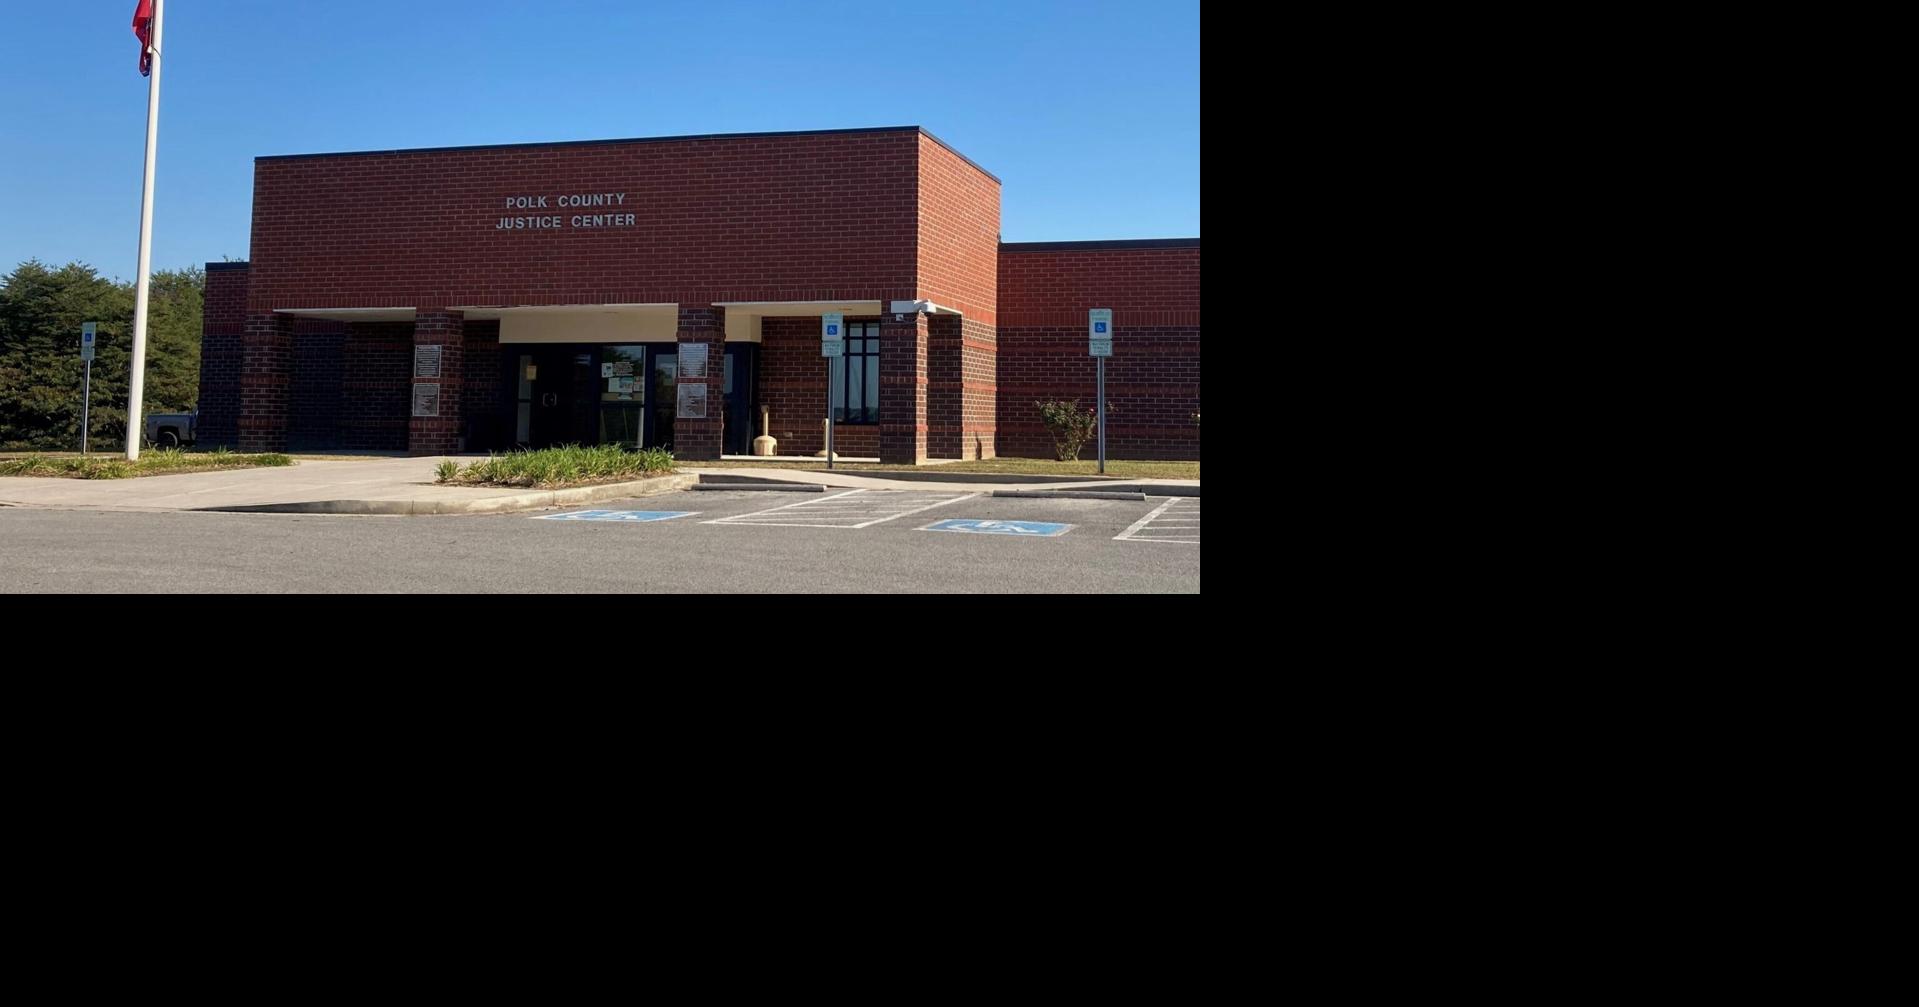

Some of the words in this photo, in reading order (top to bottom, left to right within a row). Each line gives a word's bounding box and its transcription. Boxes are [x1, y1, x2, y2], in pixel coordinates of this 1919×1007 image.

[506, 196, 547, 209] POLK
[558, 193, 625, 207] COUNTY
[496, 216, 562, 229] JUSTICE
[571, 214, 636, 228] CENTER
